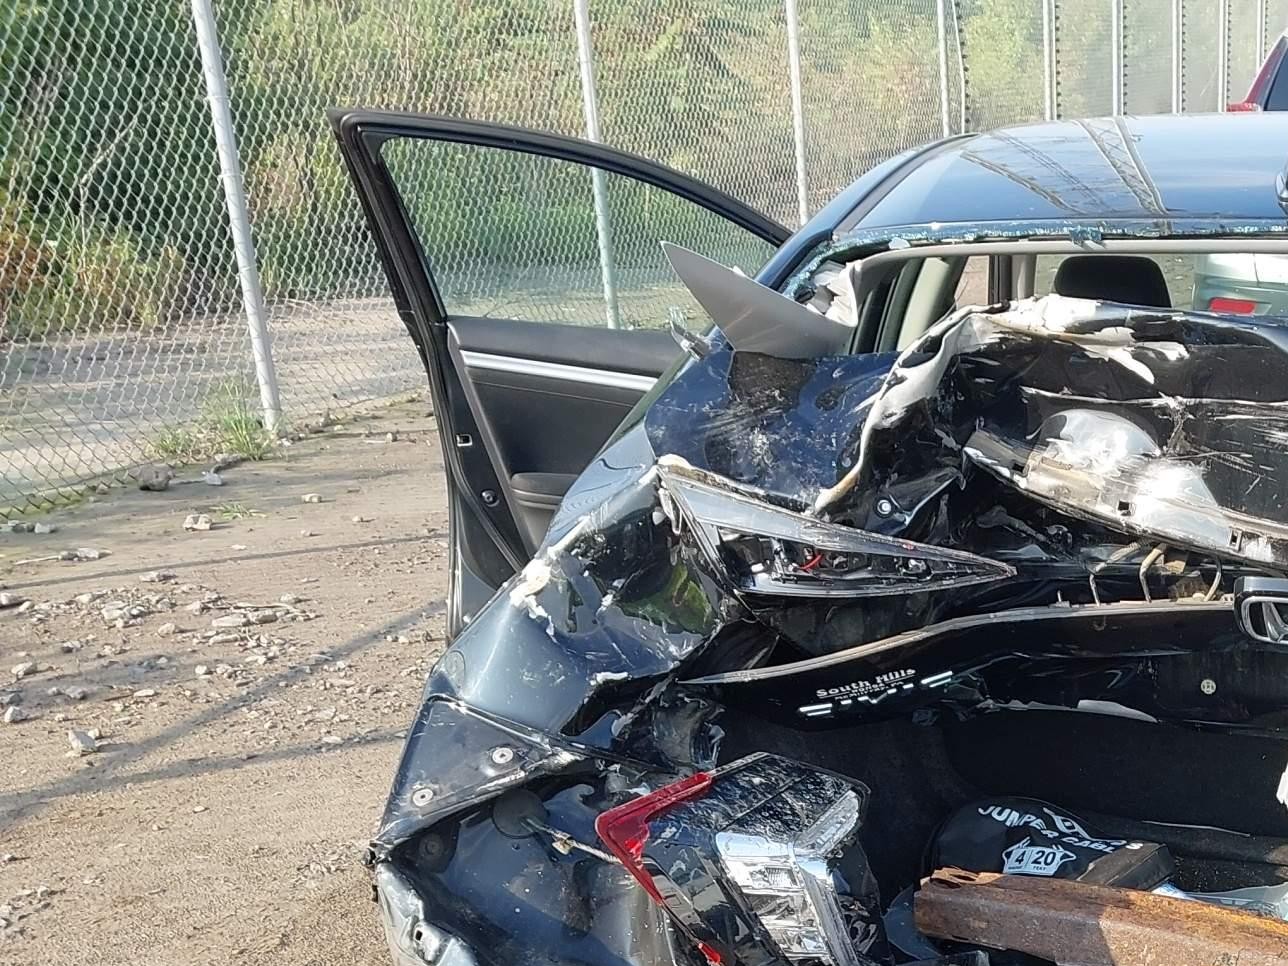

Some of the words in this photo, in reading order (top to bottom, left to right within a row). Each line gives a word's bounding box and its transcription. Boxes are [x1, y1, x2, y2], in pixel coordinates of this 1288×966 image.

[816, 680, 872, 697] South
[875, 668, 916, 684] Hills
[1060, 836, 1144, 854] CABLS
[1015, 850, 1027, 865] 4
[1031, 849, 1057, 867] 20
